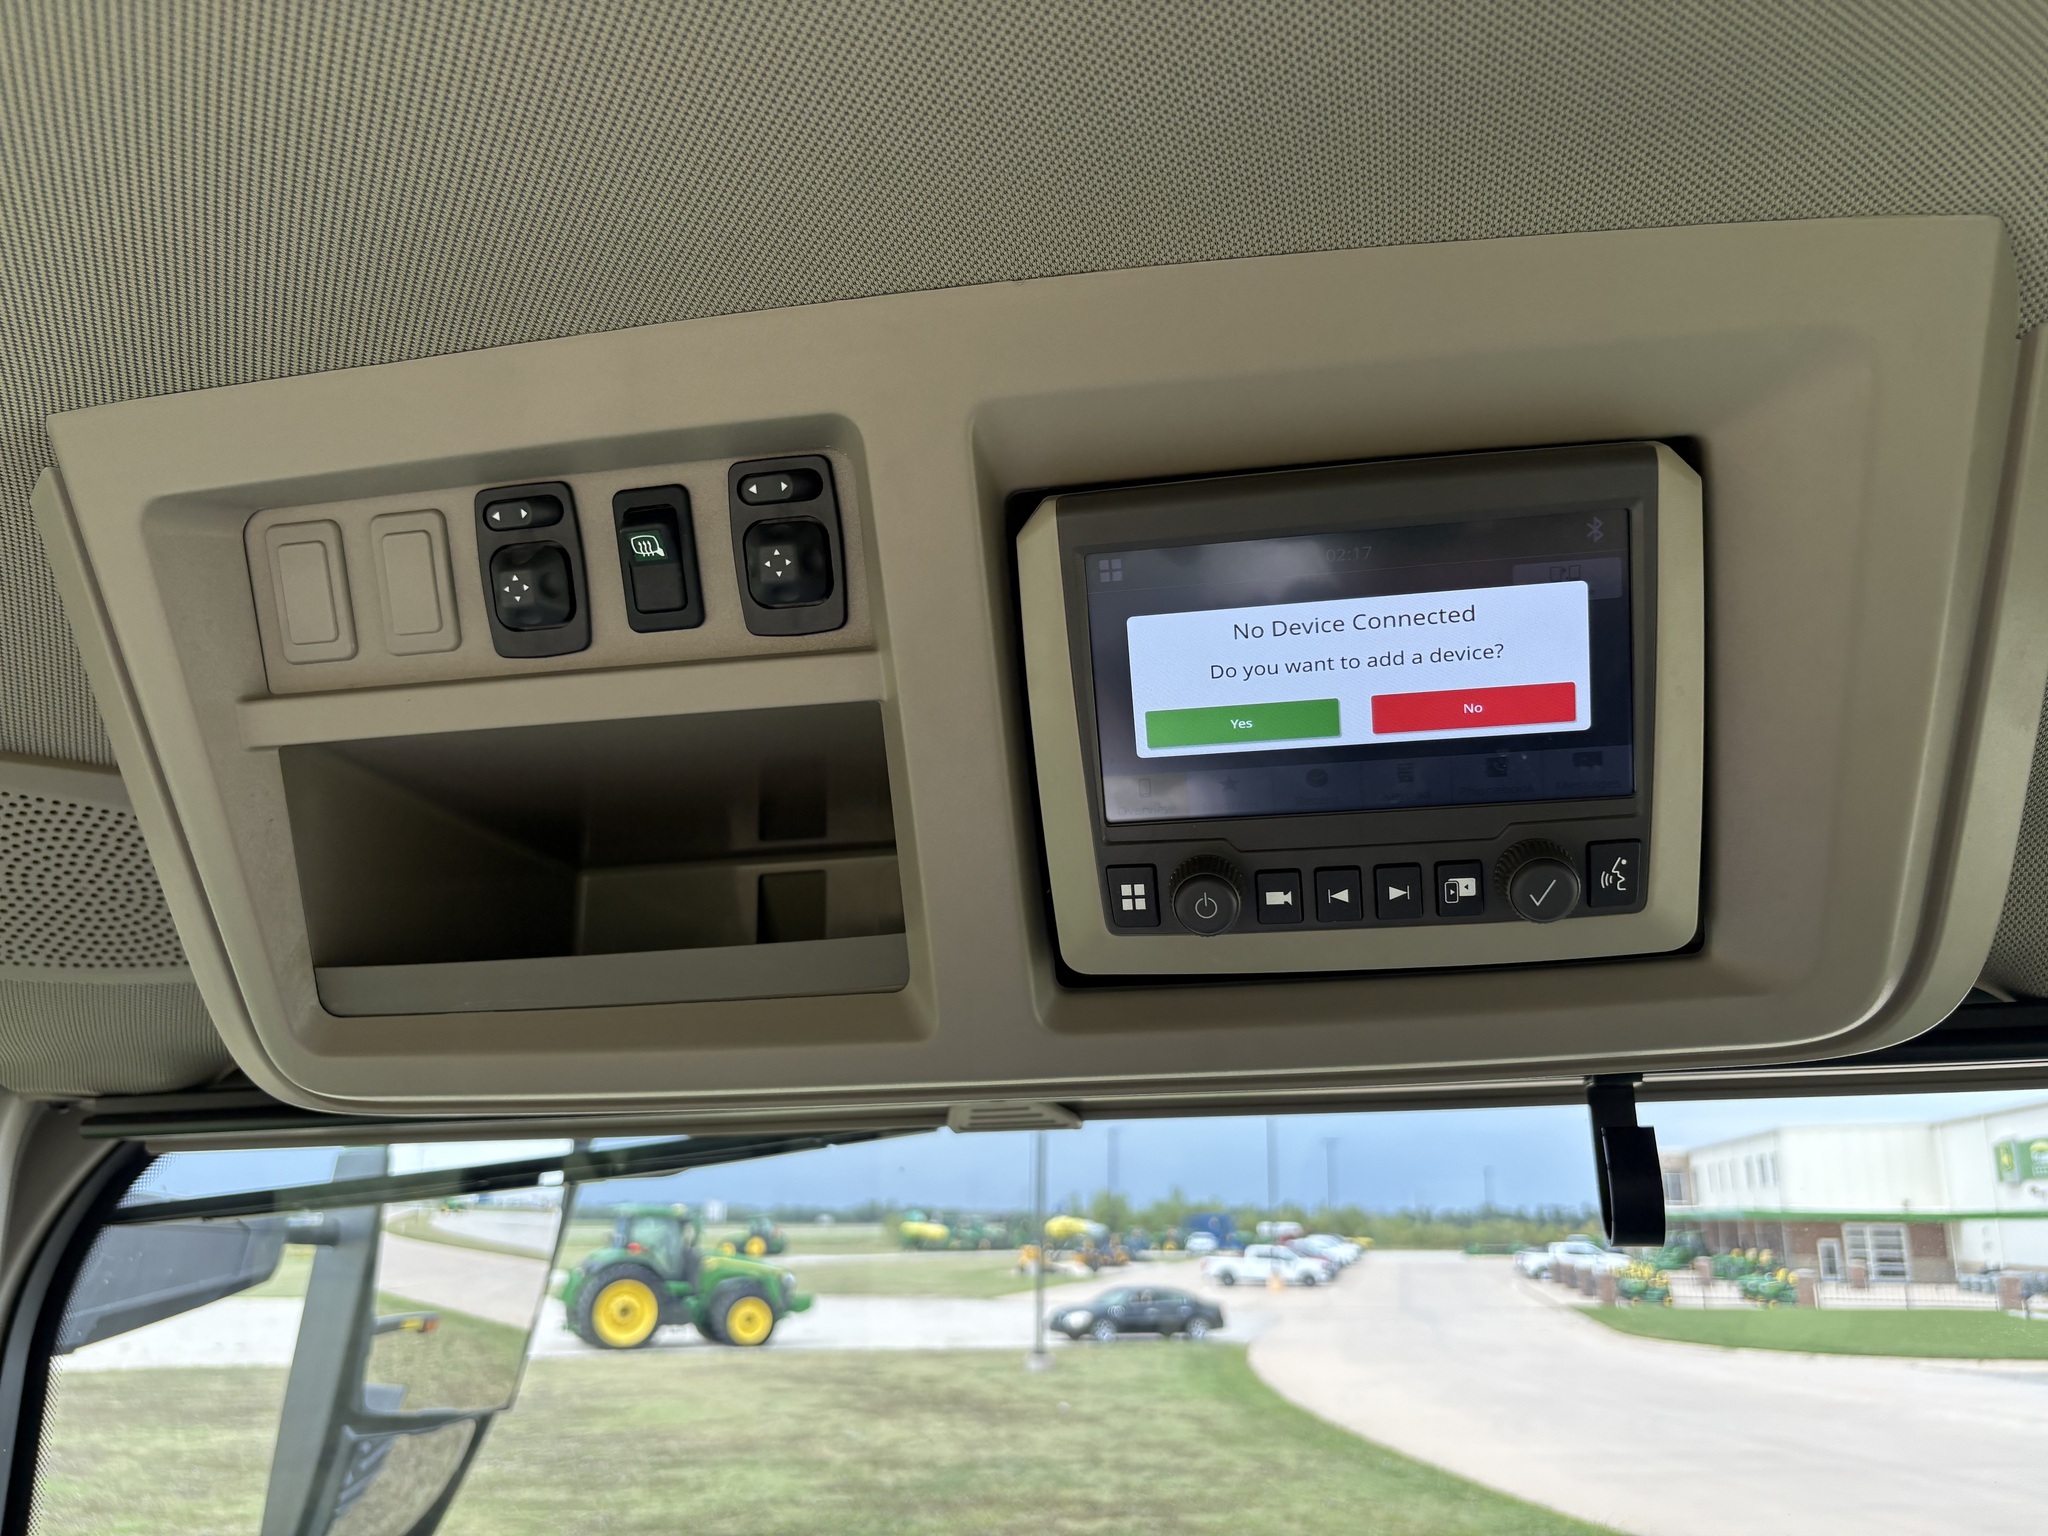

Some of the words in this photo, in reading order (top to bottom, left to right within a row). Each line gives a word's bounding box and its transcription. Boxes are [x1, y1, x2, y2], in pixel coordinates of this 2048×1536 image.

[1326, 545, 1373, 562] 02:17
[1233, 622, 1264, 640] No
[1271, 617, 1345, 637] Device
[1352, 604, 1476, 631] Connected
[1210, 664, 1237, 680] Do
[1242, 664, 1279, 681] you
[1285, 657, 1335, 674] want
[1341, 655, 1360, 670] to
[1366, 650, 1405, 668] add
[1411, 652, 1423, 665] a
[1429, 643, 1504, 664] device?
[1463, 703, 1484, 714] No
[1229, 718, 1253, 730] Yes
